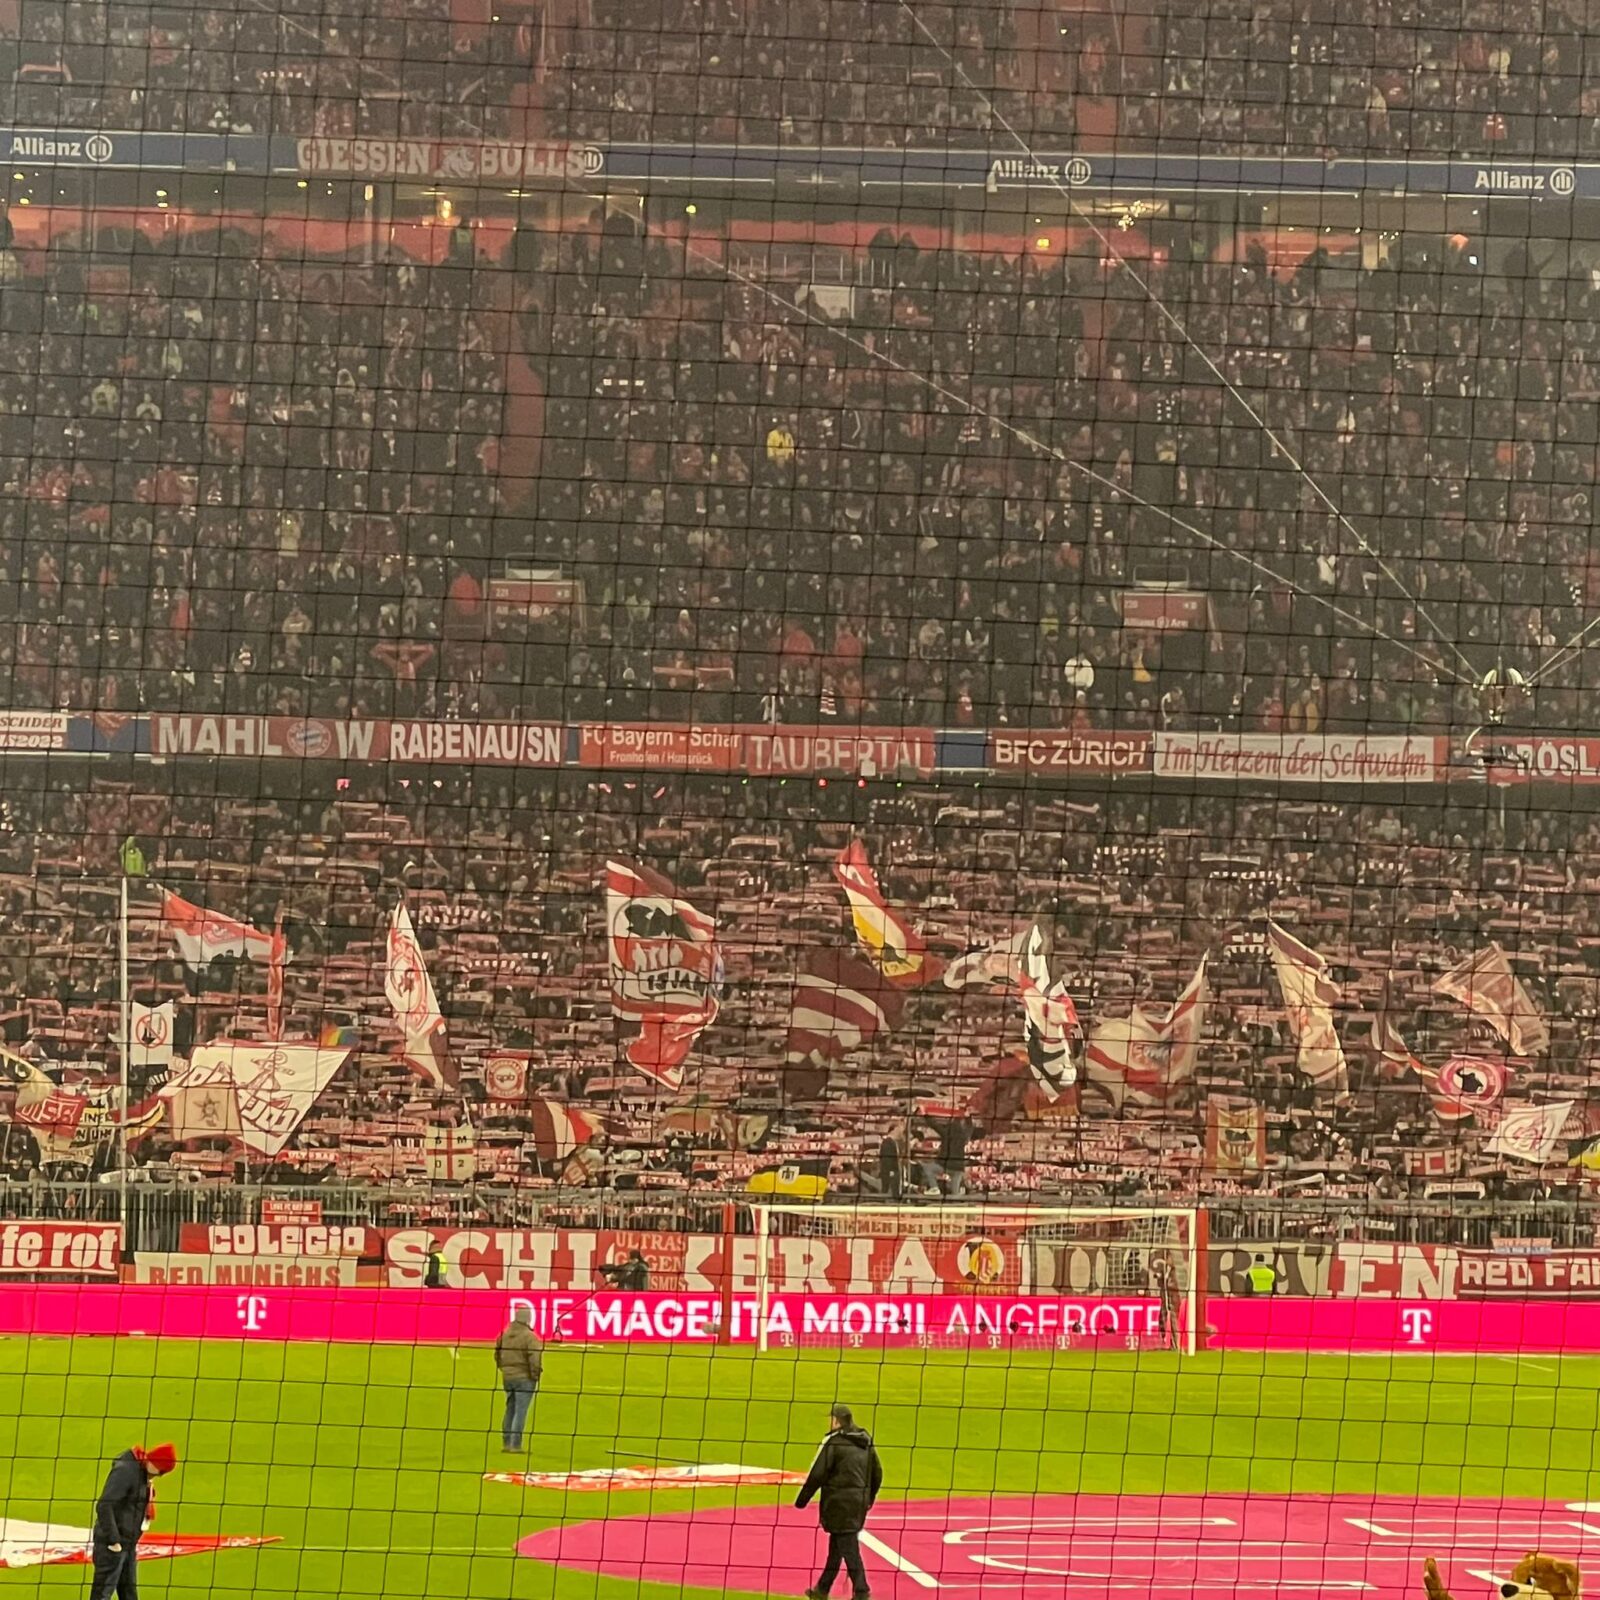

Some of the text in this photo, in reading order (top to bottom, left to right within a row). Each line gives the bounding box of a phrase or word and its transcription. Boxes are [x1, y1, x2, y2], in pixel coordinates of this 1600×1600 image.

[10, 137, 81, 157] Allianz
[297, 139, 586, 179] GIESSEN BULLS
[991, 159, 1061, 181] Allianz
[1474, 168, 1545, 191] Allianz
[158, 717, 283, 756] MAHL
[389, 723, 561, 763] RABENAU/SN
[612, 726, 674, 751] Bayern
[750, 734, 928, 773] TAUBERTAL
[995, 735, 1148, 767] BFC ZÜRICH
[1159, 737, 1428, 780] Im Herzen der Schwalm
[1516, 742, 1600, 777] RÖSL
[50, 1229, 118, 1270] rot
[615, 1231, 686, 1252] ULTRAS
[614, 1251, 686, 1273] GGEN
[509, 1297, 574, 1337] DIE
[803, 1301, 925, 1335] MOBIL
